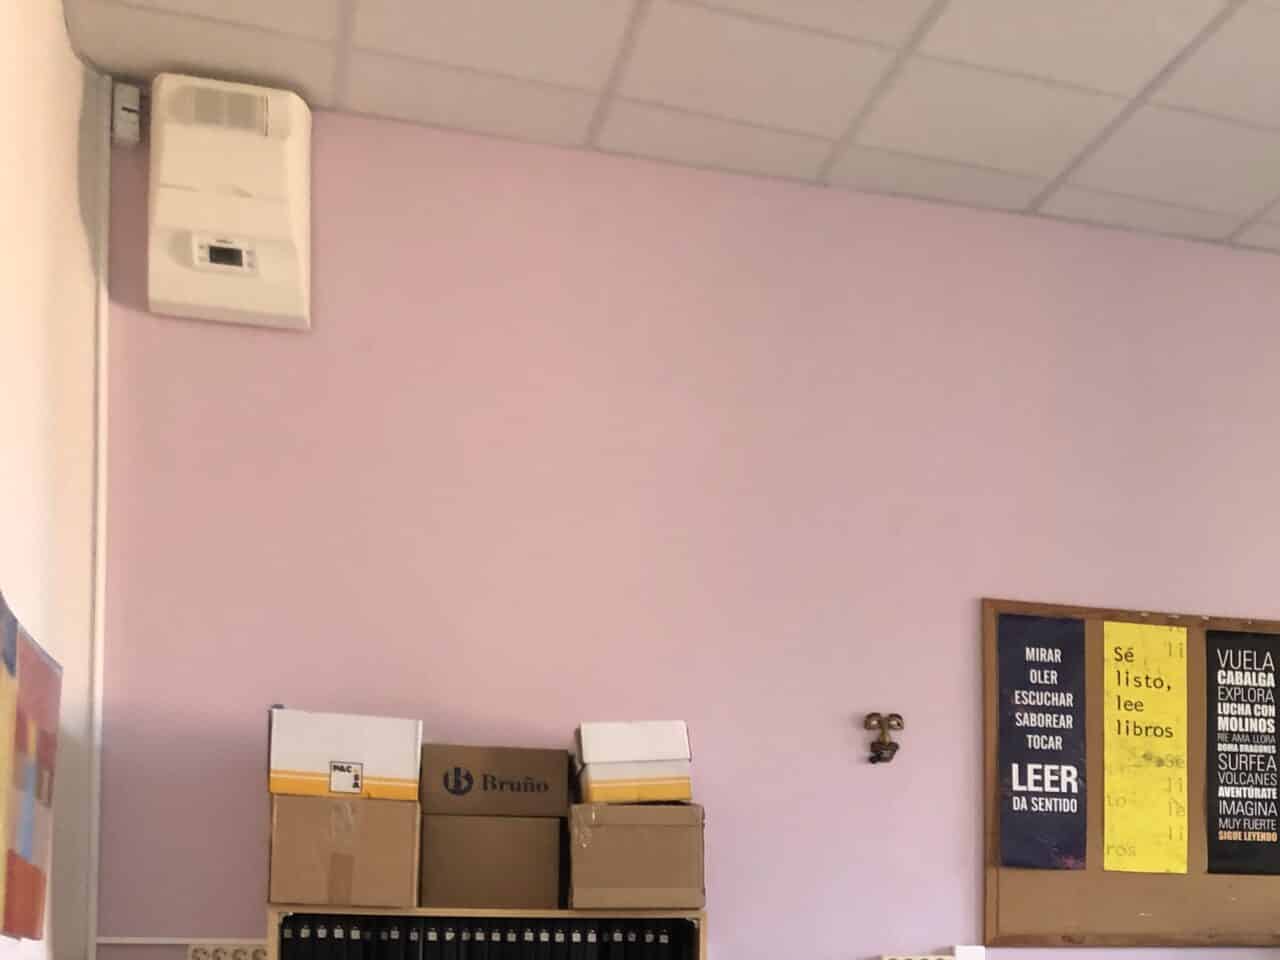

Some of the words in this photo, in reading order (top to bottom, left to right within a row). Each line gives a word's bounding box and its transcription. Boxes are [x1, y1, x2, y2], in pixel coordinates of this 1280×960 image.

[1025, 647, 1061, 663] MIRAR
[1114, 646, 1134, 663] Sé
[1217, 648, 1275, 671] VUELA
[1029, 669, 1058, 684] OLER
[1116, 670, 1172, 691] listo,
[1217, 669, 1275, 687] CABALGA
[1014, 690, 1073, 707] ESCUCHAR
[1217, 686, 1275, 703] EXPLORA
[1117, 695, 1144, 712] lee
[1217, 702, 1252, 716] LUCHA
[1253, 704, 1275, 717] CON
[1015, 712, 1073, 729] SABOREAR
[1117, 720, 1173, 738] libros
[1217, 716, 1276, 734] MOLINOS
[1027, 734, 1062, 750] TOCAR
[1218, 752, 1277, 772] SURFEA
[481, 773, 550, 793] Bruño
[1011, 763, 1078, 793] LEER
[1217, 771, 1277, 786] VOLCANES
[1012, 796, 1028, 811] DA
[1031, 797, 1078, 813] SENTIDO
[1218, 799, 1278, 817] IMAGINA
[1218, 818, 1241, 829] MUY
[1243, 819, 1277, 831] FUERTE
